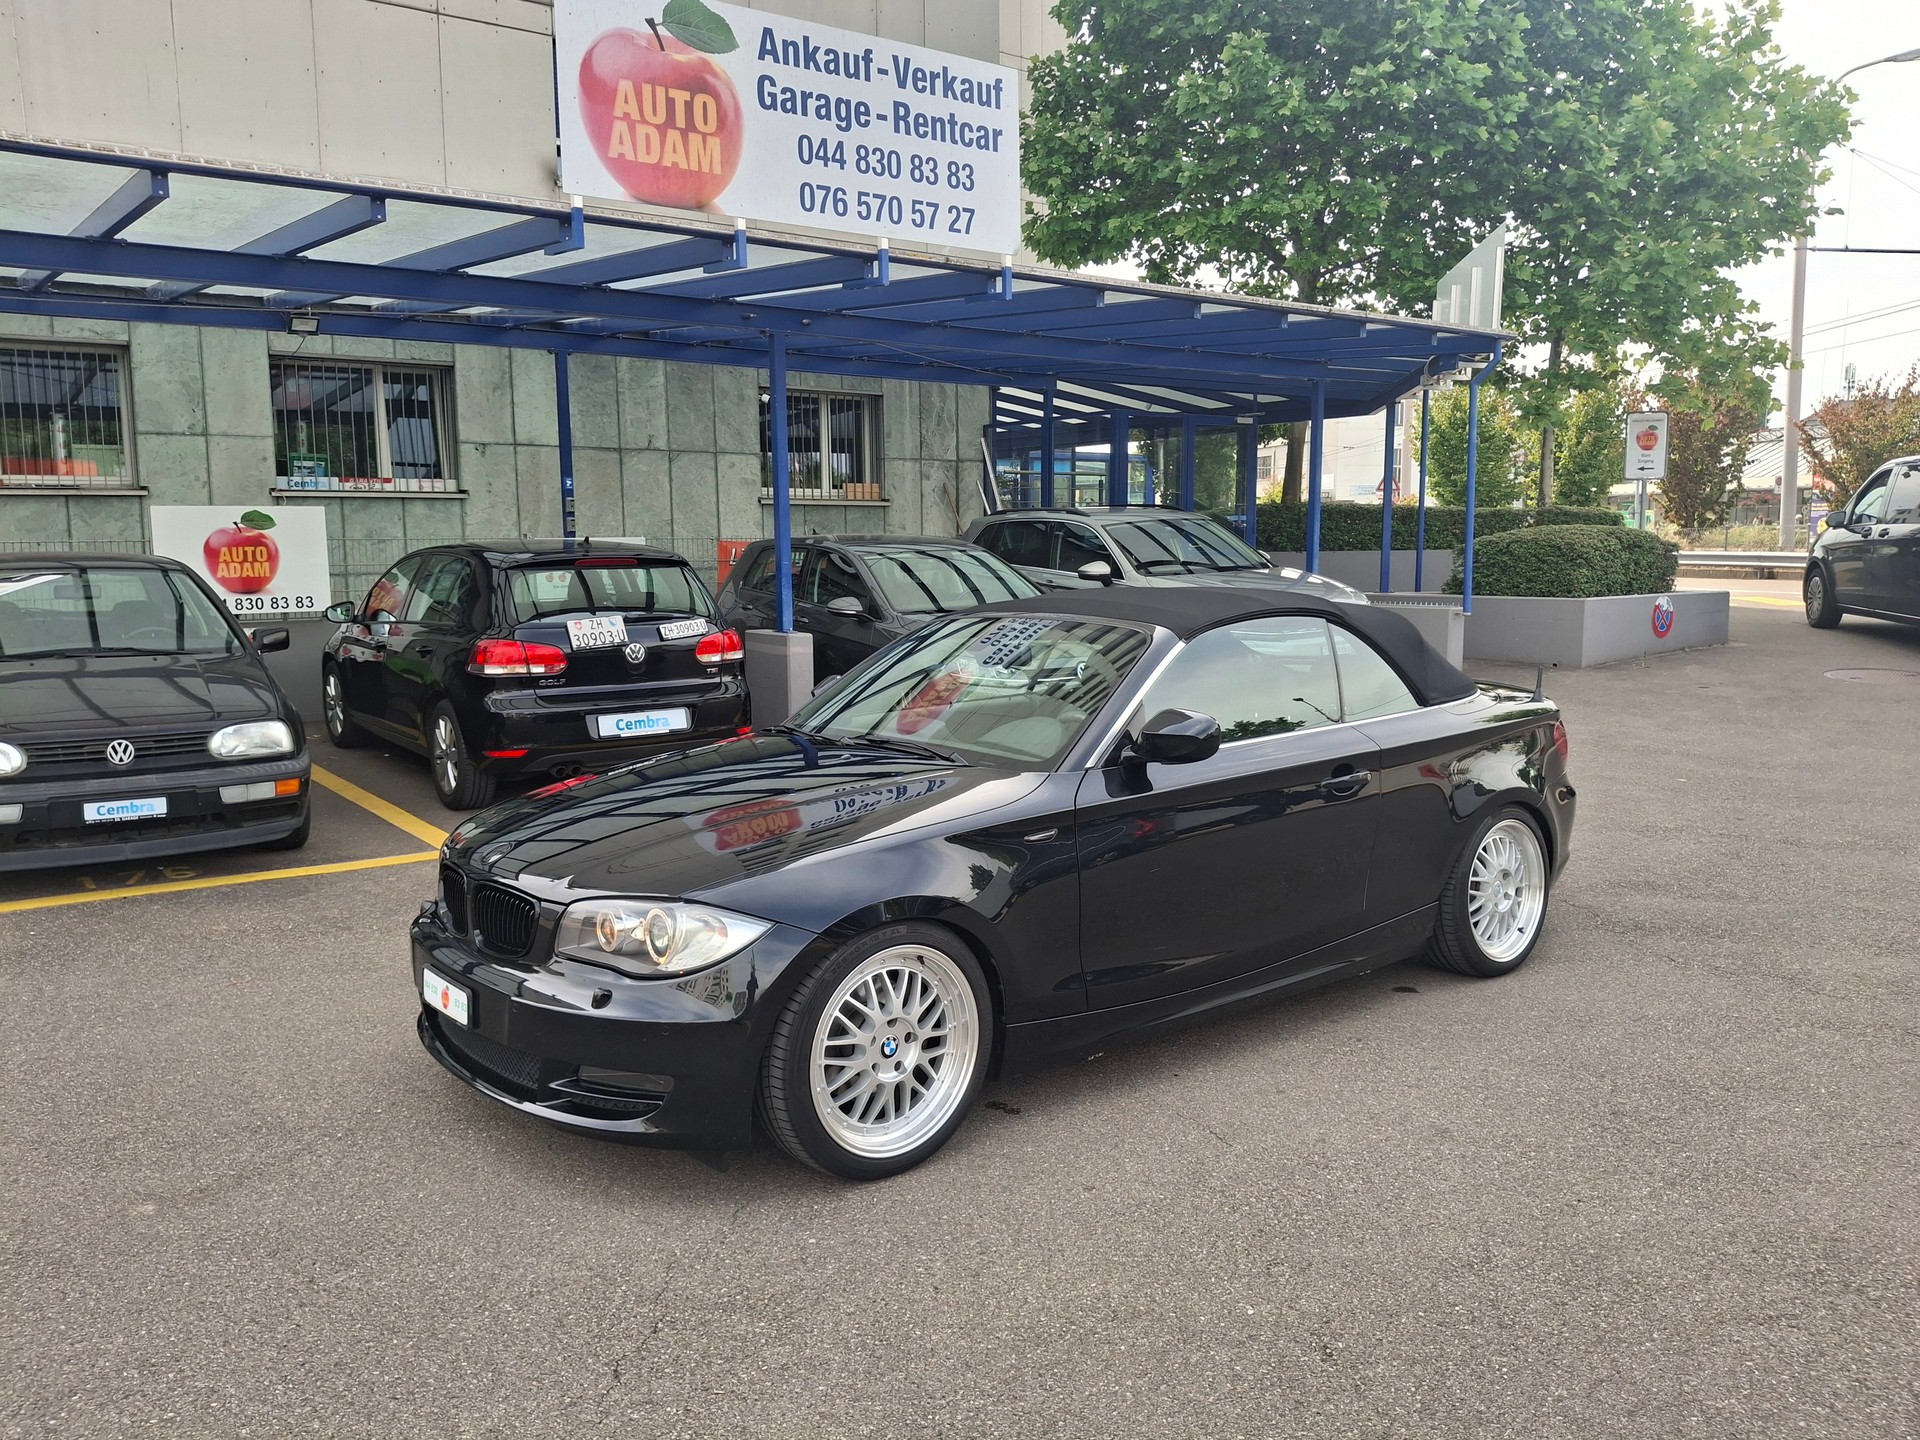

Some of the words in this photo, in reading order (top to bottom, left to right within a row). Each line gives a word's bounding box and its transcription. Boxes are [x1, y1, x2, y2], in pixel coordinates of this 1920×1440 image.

[757, 26, 1003, 110] Ankauf-Verkauf
[613, 78, 718, 135] AUTO
[756, 74, 1003, 153] Garage-Rentcar
[608, 121, 722, 175] ADAM
[797, 134, 847, 170] 044
[855, 144, 902, 180] 830
[909, 153, 939, 186] 83
[946, 162, 975, 192] 83
[799, 181, 849, 217] 076
[856, 190, 903, 225] 570
[910, 198, 939, 230] 57
[947, 205, 976, 235] 27
[287, 479, 327, 489] Cembra
[219, 546, 268, 562] AUTO
[216, 562, 270, 578] ADAM
[235, 597, 264, 611] 830
[271, 596, 289, 609] 83
[296, 596, 314, 609] 83
[590, 620, 603, 630] ZH
[538, 679, 566, 687] GOLF
[615, 715, 670, 731] Cembra
[96, 802, 156, 816] Cembra
